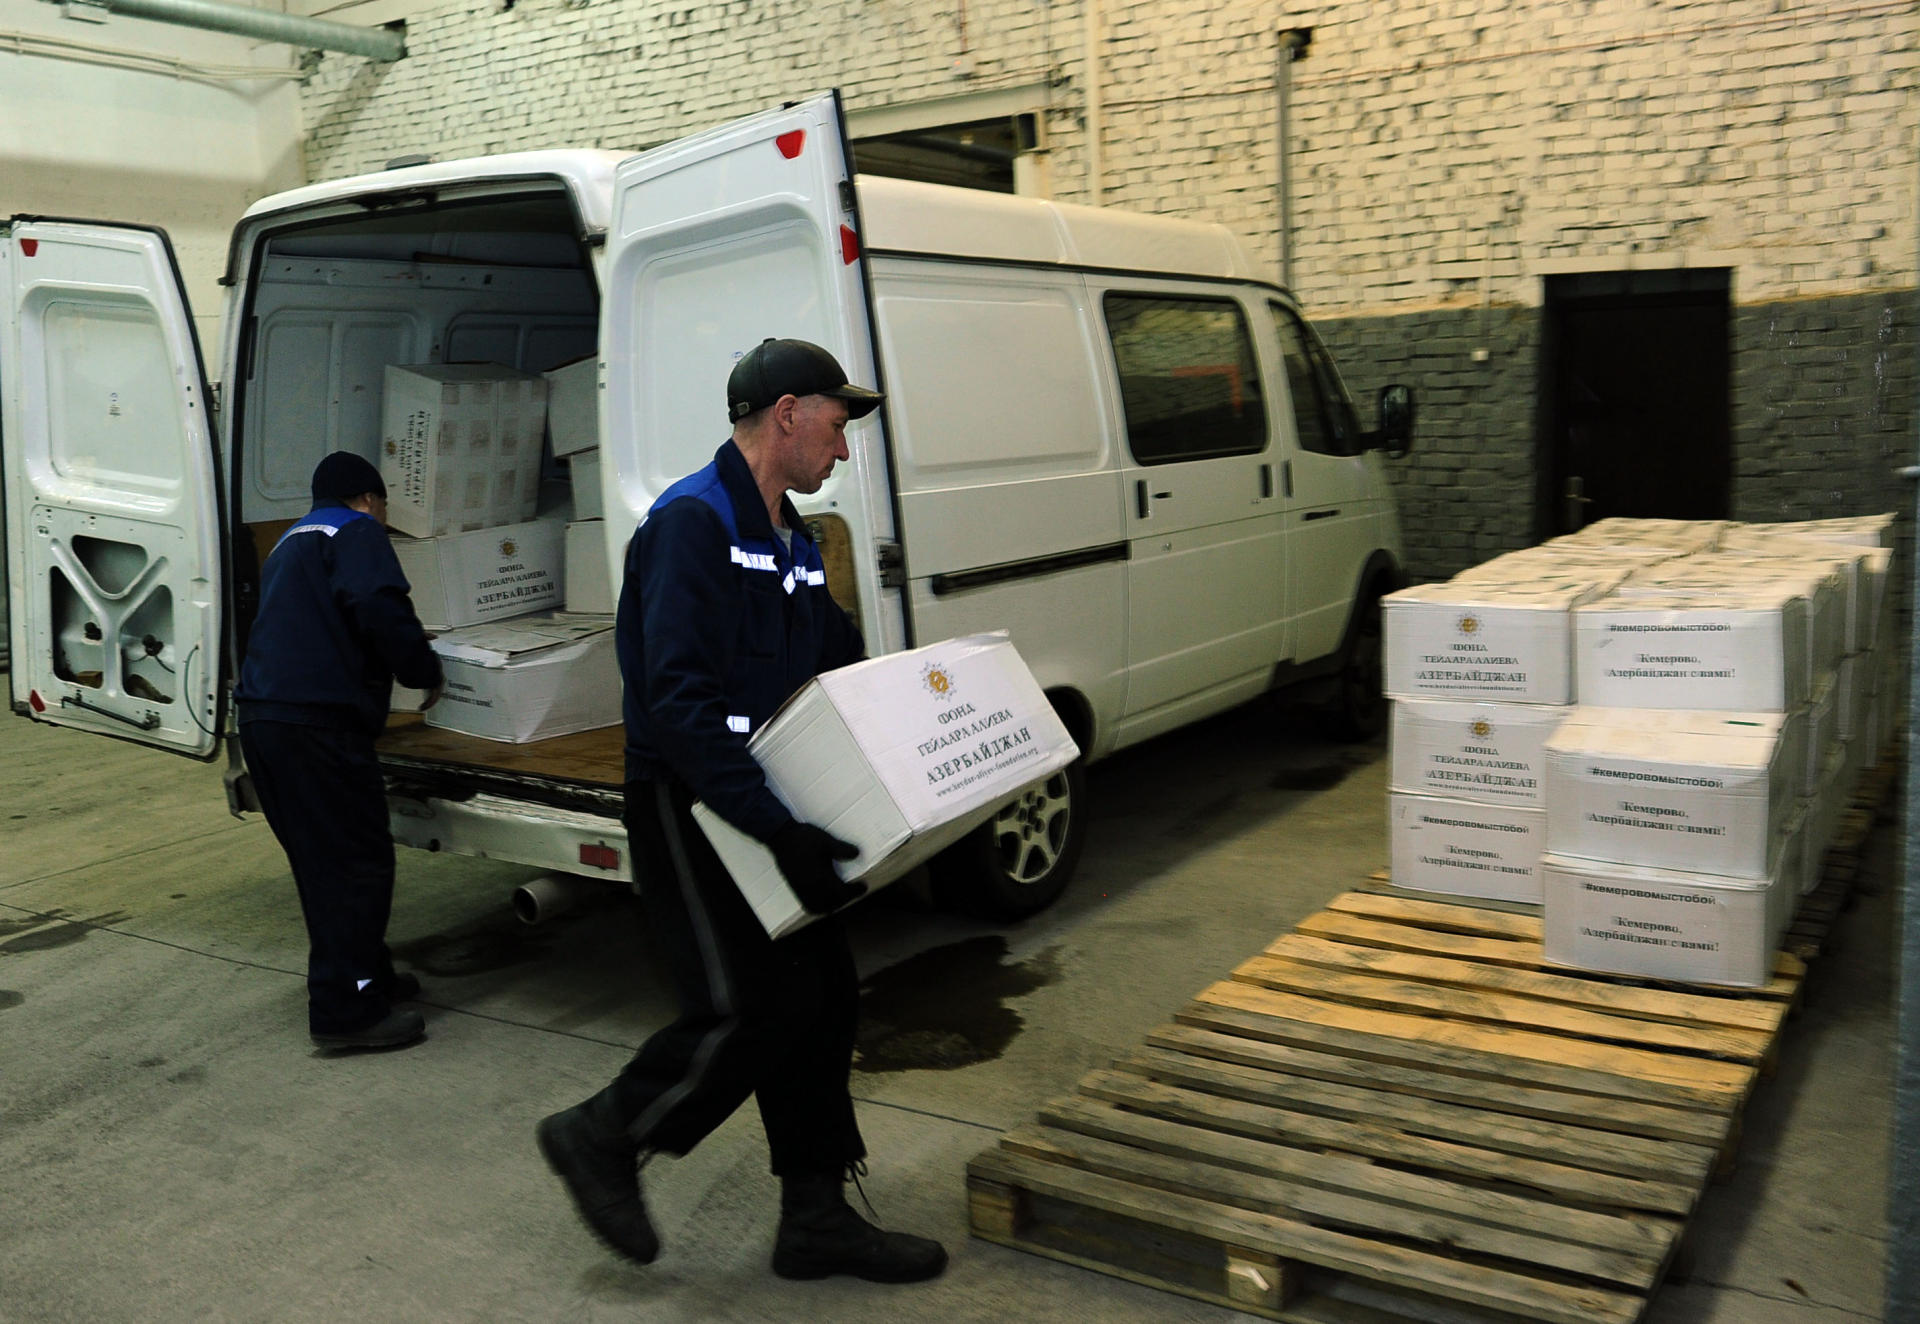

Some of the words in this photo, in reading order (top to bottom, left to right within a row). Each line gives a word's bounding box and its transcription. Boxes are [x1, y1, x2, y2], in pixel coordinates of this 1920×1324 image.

[476, 581, 555, 605] АЗЕРБАЙДЖАН
[1638, 653, 1701, 665] Кемерово,
[1416, 669, 1527, 682] АЗЕРБАЙДЖАН
[1608, 667, 1687, 679] Азербайджан
[1699, 669, 1736, 678] вами!
[937, 702, 976, 726] ФОНД
[917, 726, 971, 757] ГЕЙДАРА
[969, 708, 1014, 738] АЛИЕВА
[926, 726, 1032, 785] АЗЕРБАЙДЖАН
[1427, 769, 1537, 789] АЗЕРБАЙДЖАН
[1590, 766, 1724, 789] #кемеровомыстобой
[1621, 801, 1689, 818] Кемерово,
[1587, 812, 1674, 831] Азербайджан
[1686, 825, 1726, 836] вами!
[1448, 845, 1503, 860] Кемерово,
[1583, 882, 1716, 905] #кемеровомыстобой
[1614, 916, 1682, 934] Кемерово,
[1582, 926, 1668, 947] Азербайджан
[1680, 940, 1719, 952] вами!
